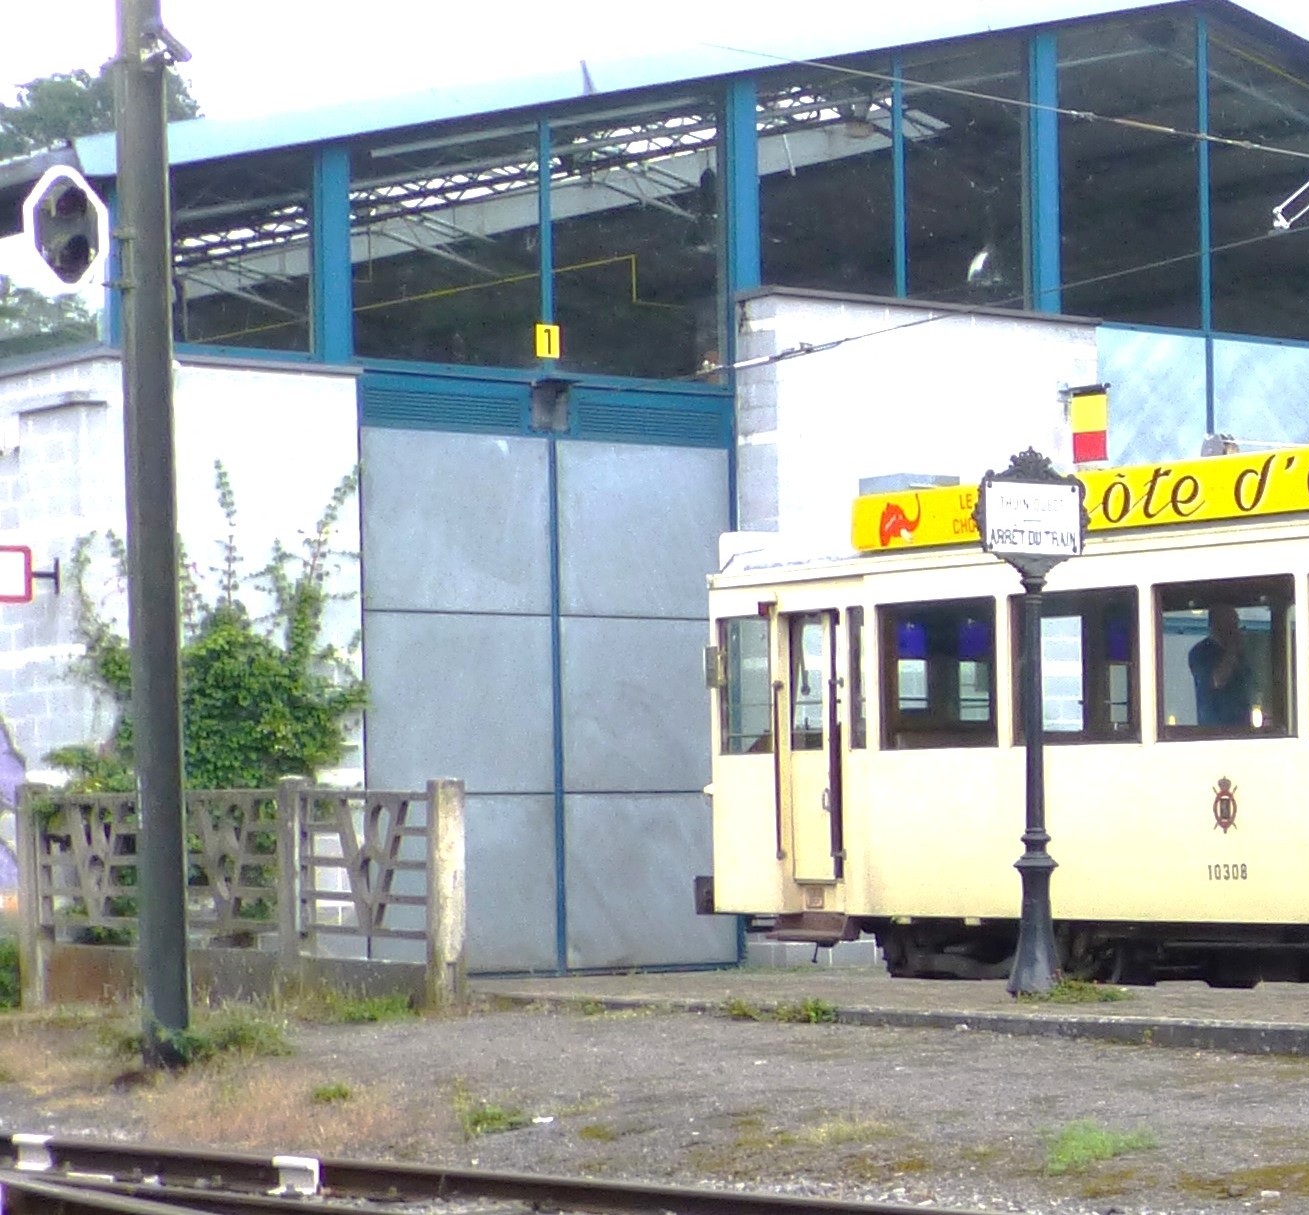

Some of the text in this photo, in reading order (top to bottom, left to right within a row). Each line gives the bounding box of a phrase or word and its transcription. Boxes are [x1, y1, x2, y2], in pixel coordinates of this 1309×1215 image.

[543, 328, 552, 355] 1
[958, 493, 972, 510] LE
[1096, 466, 1206, 524] ôte
[1028, 530, 1042, 546] DU
[1207, 862, 1248, 881] 10308
